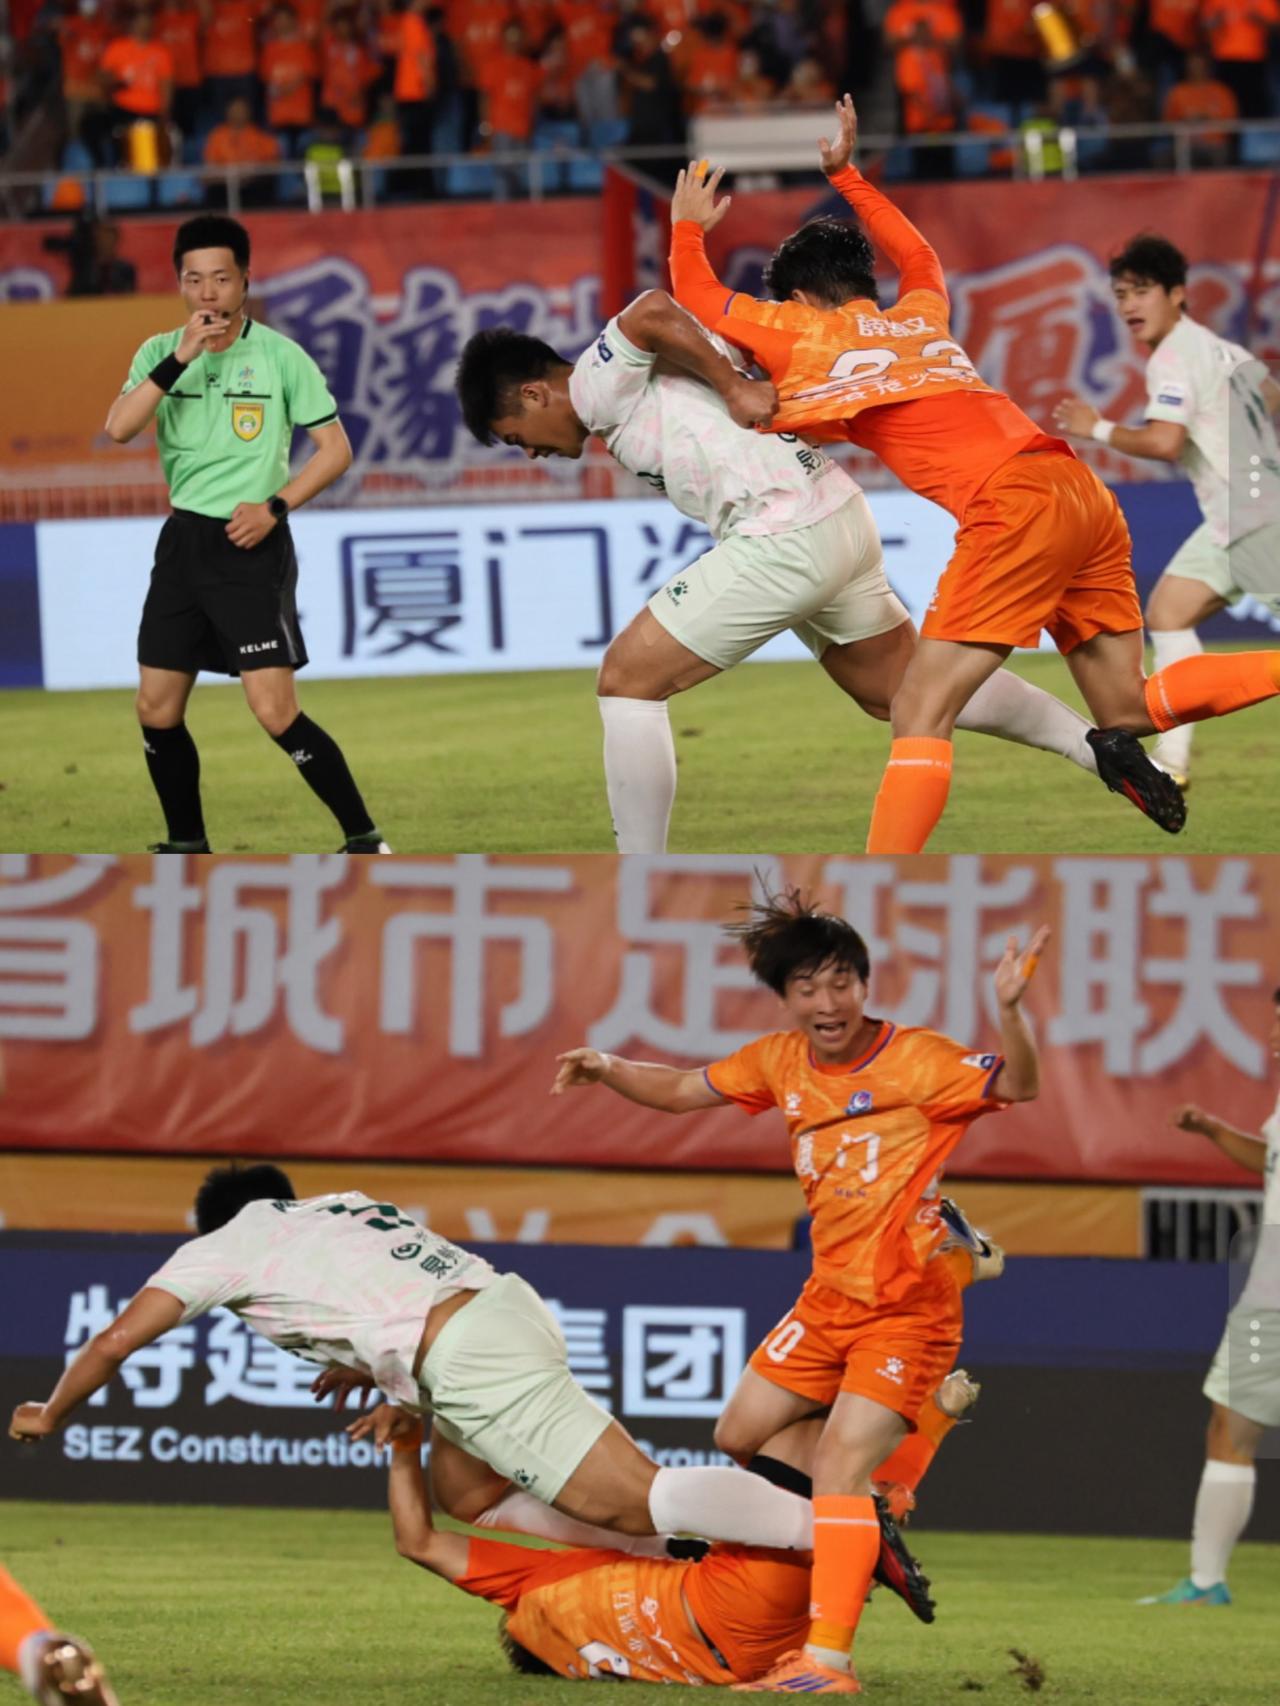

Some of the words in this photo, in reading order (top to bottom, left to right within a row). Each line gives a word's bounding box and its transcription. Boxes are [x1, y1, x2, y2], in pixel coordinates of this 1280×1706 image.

[239, 640, 278, 655] KELME
[761, 1309, 805, 1363] 0
[63, 1425, 143, 1462] SEZ
[150, 1427, 392, 1467] Construction
